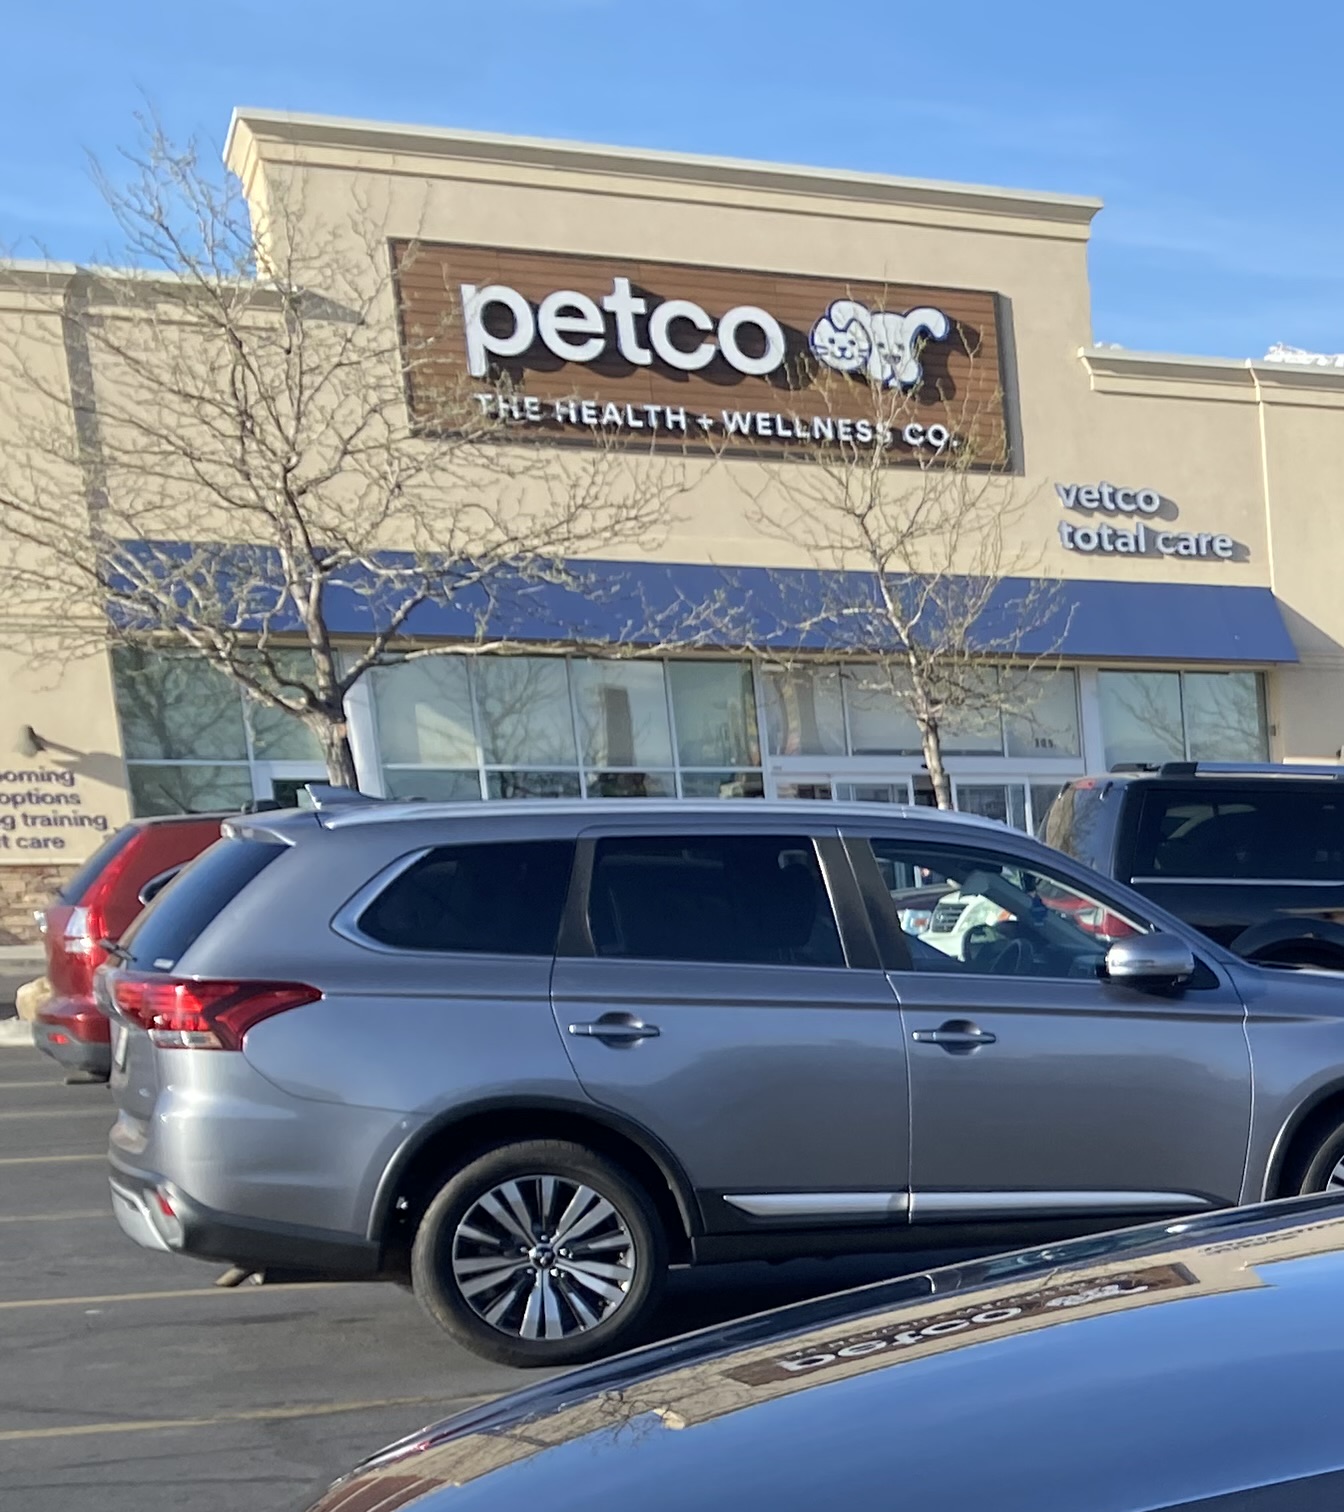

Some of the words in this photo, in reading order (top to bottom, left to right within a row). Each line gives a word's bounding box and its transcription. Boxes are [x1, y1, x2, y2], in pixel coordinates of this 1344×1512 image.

[459, 276, 787, 377] petco
[476, 394, 541, 422] THE
[555, 400, 686, 430] HEALTH
[697, 414, 714, 431] +
[723, 410, 894, 444] WELLNESS
[903, 423, 959, 448] CO.
[1056, 481, 1160, 513] vetco
[1058, 519, 1146, 553] total
[1156, 532, 1233, 557] care
[0, 767, 74, 786] oming
[22, 811, 108, 830] training
[16, 837, 65, 849] care
